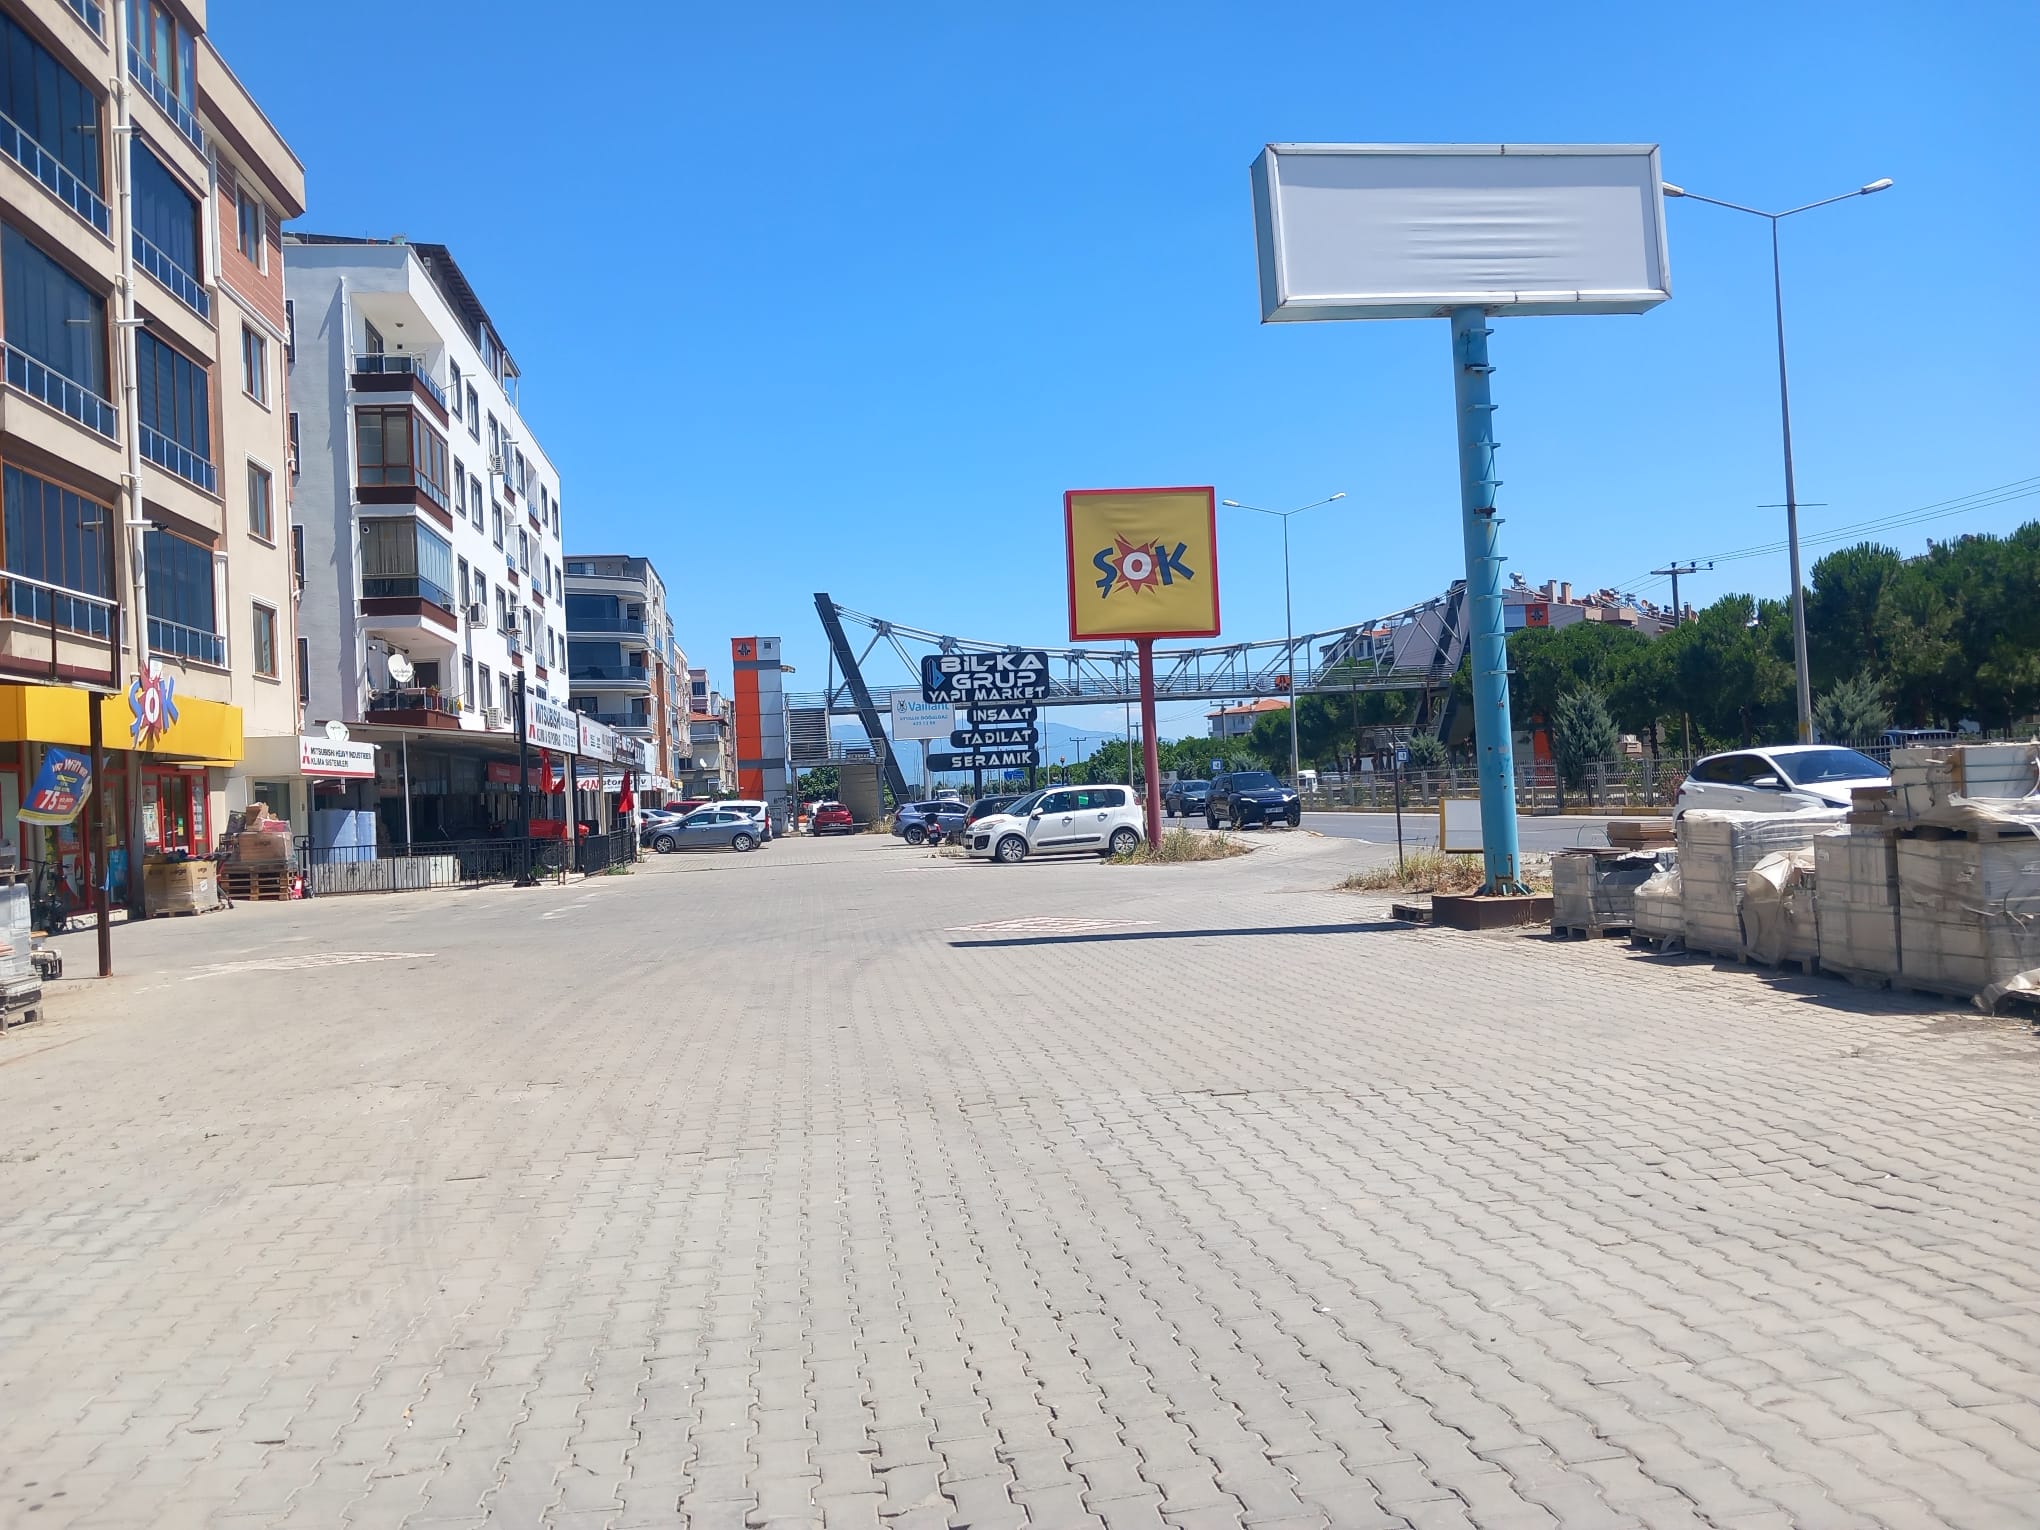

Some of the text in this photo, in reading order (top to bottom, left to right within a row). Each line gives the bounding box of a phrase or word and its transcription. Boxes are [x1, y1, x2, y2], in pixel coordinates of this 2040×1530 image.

[1093, 542, 1194, 599] ŞOK
[928, 686, 1045, 703] YAPI MARKET
[952, 671, 1036, 689] GRUP
[128, 675, 178, 750] ŞOK
